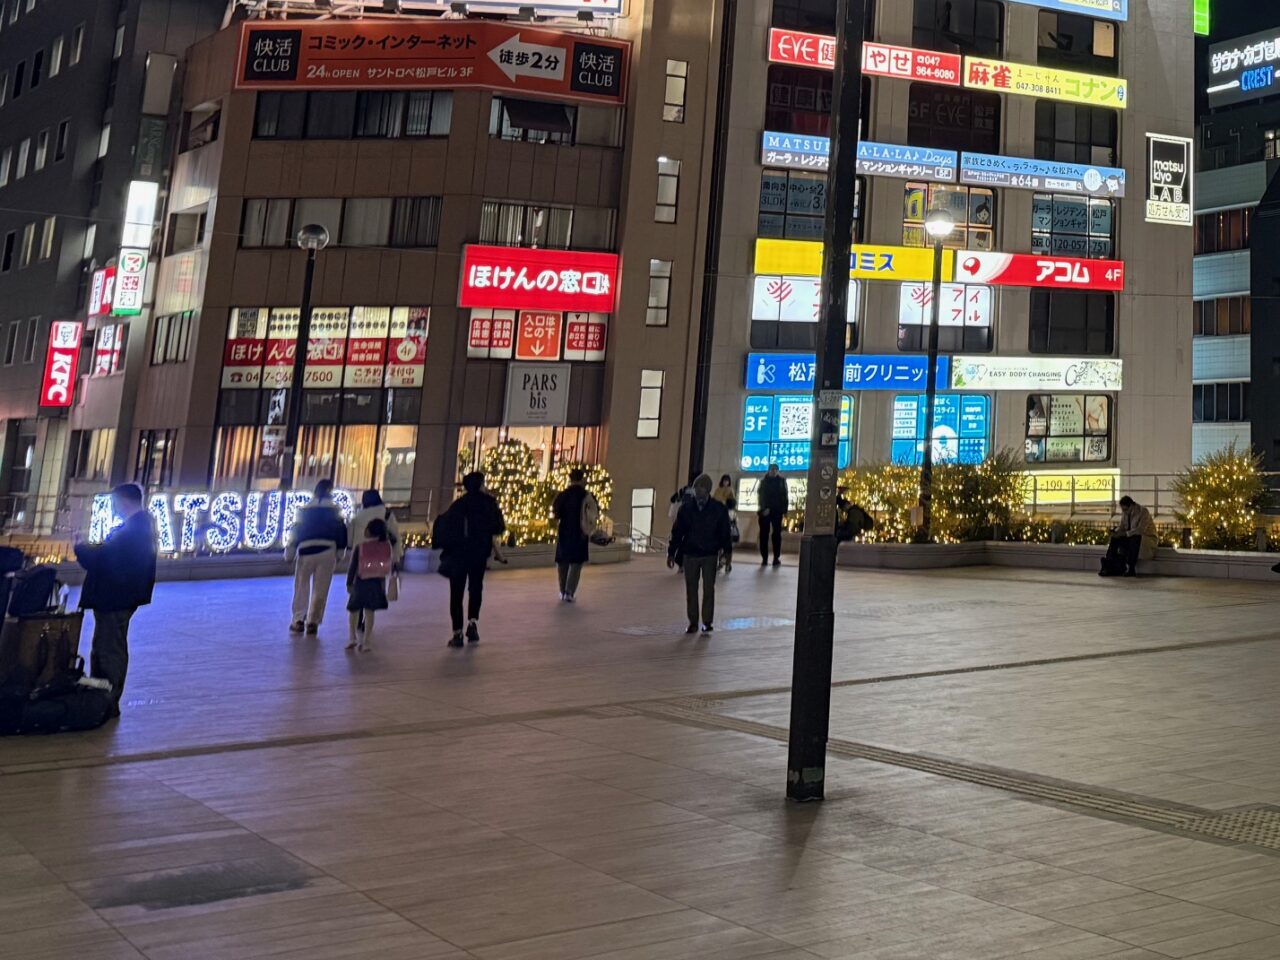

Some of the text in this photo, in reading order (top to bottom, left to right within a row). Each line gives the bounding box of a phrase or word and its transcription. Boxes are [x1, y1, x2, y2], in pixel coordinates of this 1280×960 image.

[253, 36, 293, 57] 快活
[252, 57, 291, 74] CLUB
[498, 48, 561, 72] 徒歩2分
[579, 52, 616, 73] 快活
[924, 55, 941, 67] 047
[332, 68, 361, 79] OPEN
[459, 65, 475, 77] 3F
[578, 71, 614, 89] CLUB
[968, 60, 1012, 89] 麻雀
[1240, 65, 1275, 91] CREST
[1064, 77, 1116, 101] コナン
[921, 150, 953, 167] Days
[1153, 159, 1184, 173] matsu
[861, 160, 934, 177] マンションギャラリー
[1153, 169, 1173, 184] kiyo
[1150, 185, 1183, 203] LAB
[468, 263, 606, 295] ほけんの窓口
[1036, 260, 1090, 284] アコム
[1104, 269, 1121, 282] 4F
[524, 314, 556, 327] 入口は
[523, 326, 556, 340] この下
[47, 351, 73, 403] KFC
[522, 373, 558, 391] PARS
[529, 392, 547, 410] bis
[744, 415, 768, 432] 3F
